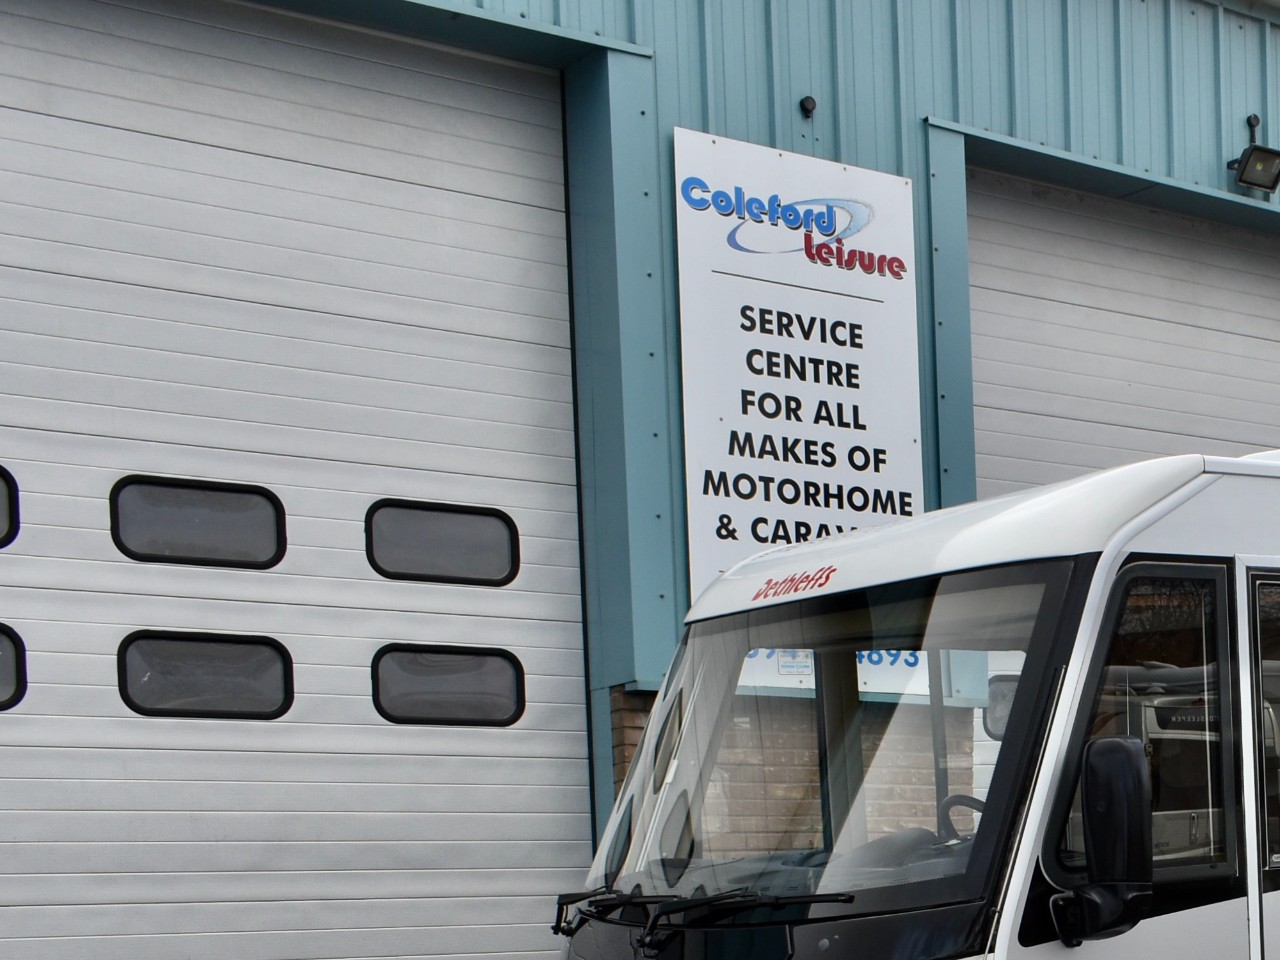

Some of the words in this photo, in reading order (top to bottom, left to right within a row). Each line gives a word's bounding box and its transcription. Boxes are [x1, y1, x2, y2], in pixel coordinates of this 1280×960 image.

[680, 176, 836, 236] Coleford
[803, 232, 907, 280] Leisure
[740, 304, 864, 350] SERVICE
[745, 348, 861, 390] CENTRE
[740, 388, 804, 423] FOR
[813, 399, 868, 431] ALL
[727, 429, 838, 469] MAKES
[847, 444, 887, 474] OF
[702, 469, 914, 518] MOTORHOME
[715, 513, 740, 541] &
[750, 516, 858, 545] CARA
[751, 565, 838, 602] Dethleffs
